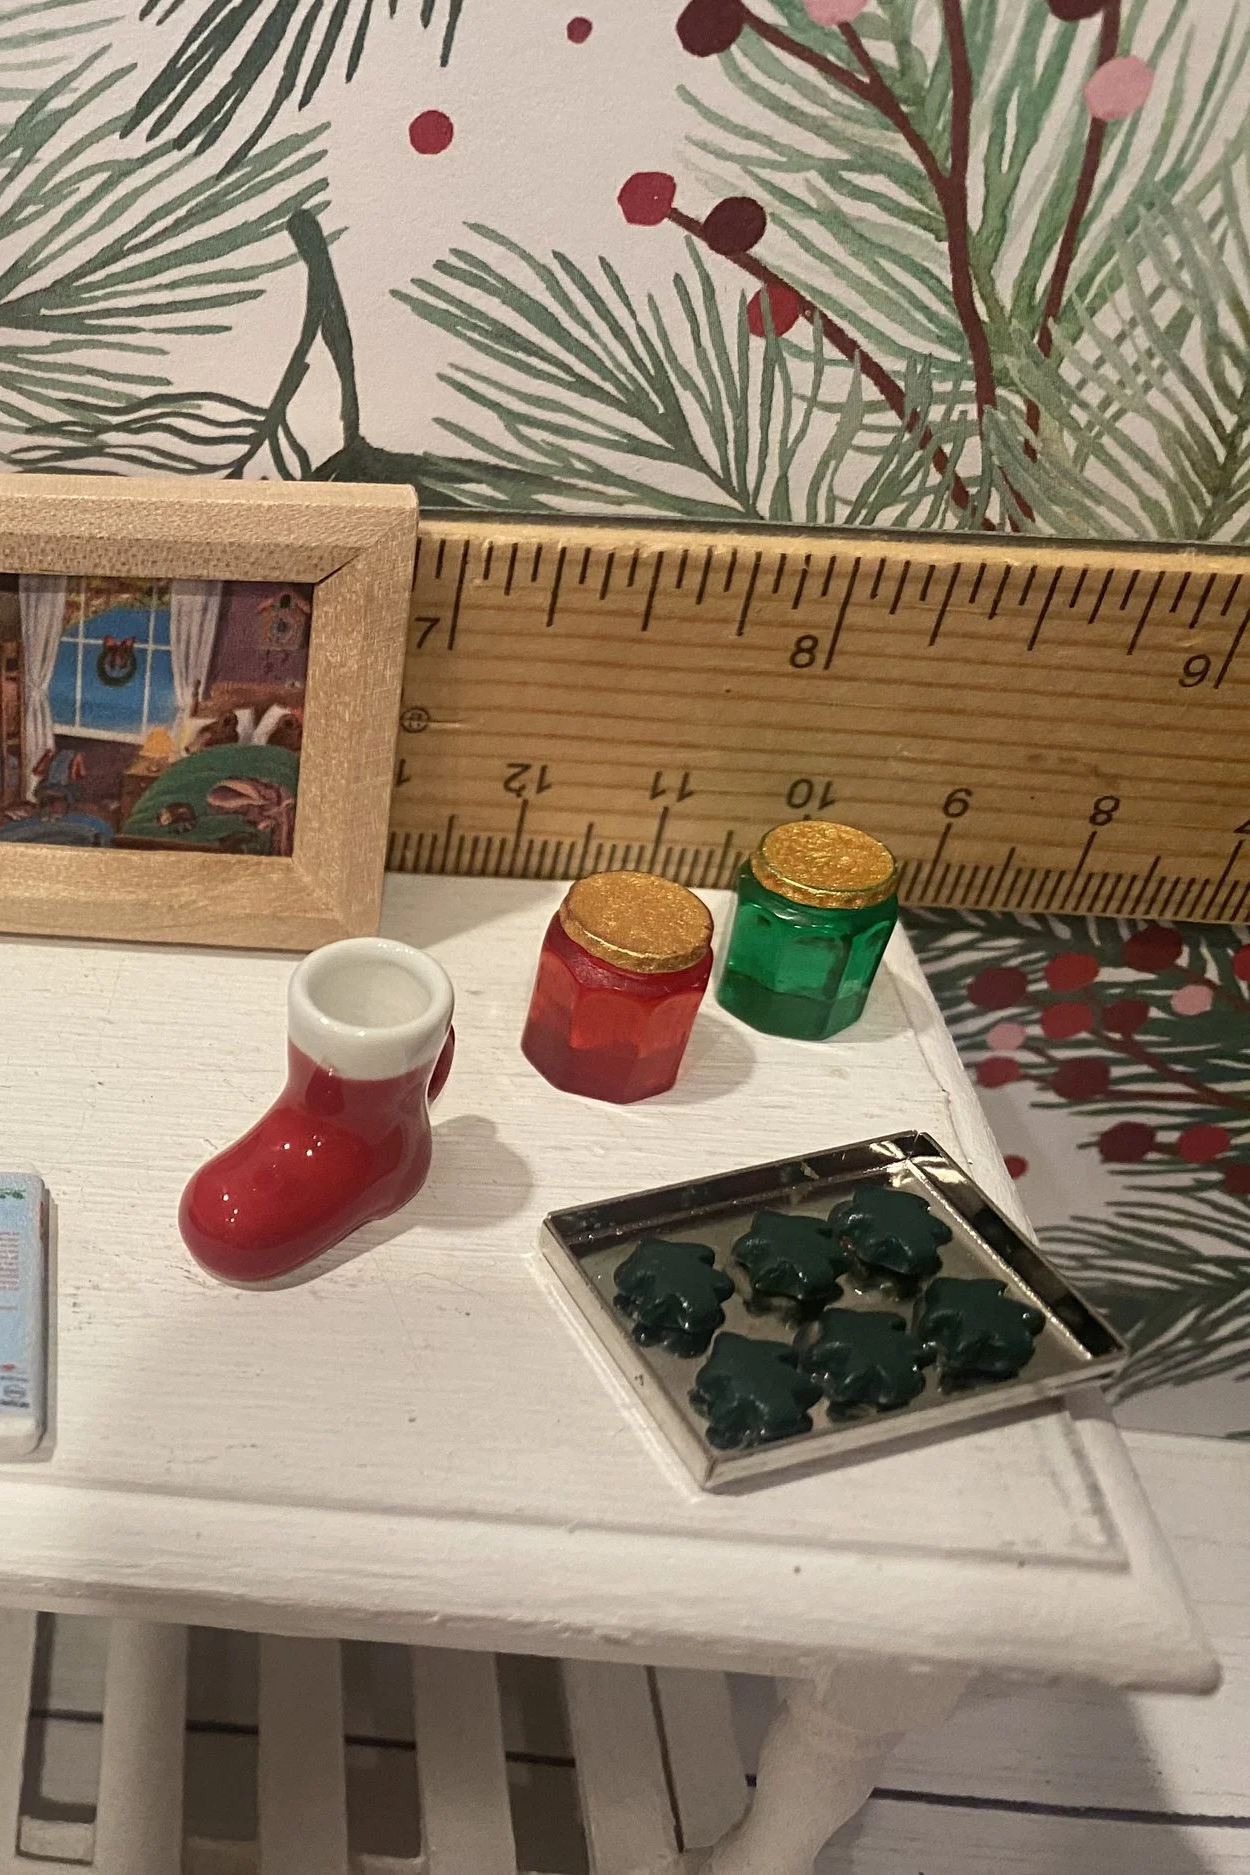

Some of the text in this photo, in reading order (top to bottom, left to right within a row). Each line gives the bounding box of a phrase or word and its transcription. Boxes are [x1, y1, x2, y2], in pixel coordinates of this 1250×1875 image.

[414, 616, 441, 650] 7
[788, 634, 820, 670] 8
[1178, 654, 1211, 689] 9
[502, 762, 553, 797] 12
[650, 770, 695, 803] 11
[785, 778, 836, 811] 10
[1088, 795, 1120, 827] 8
